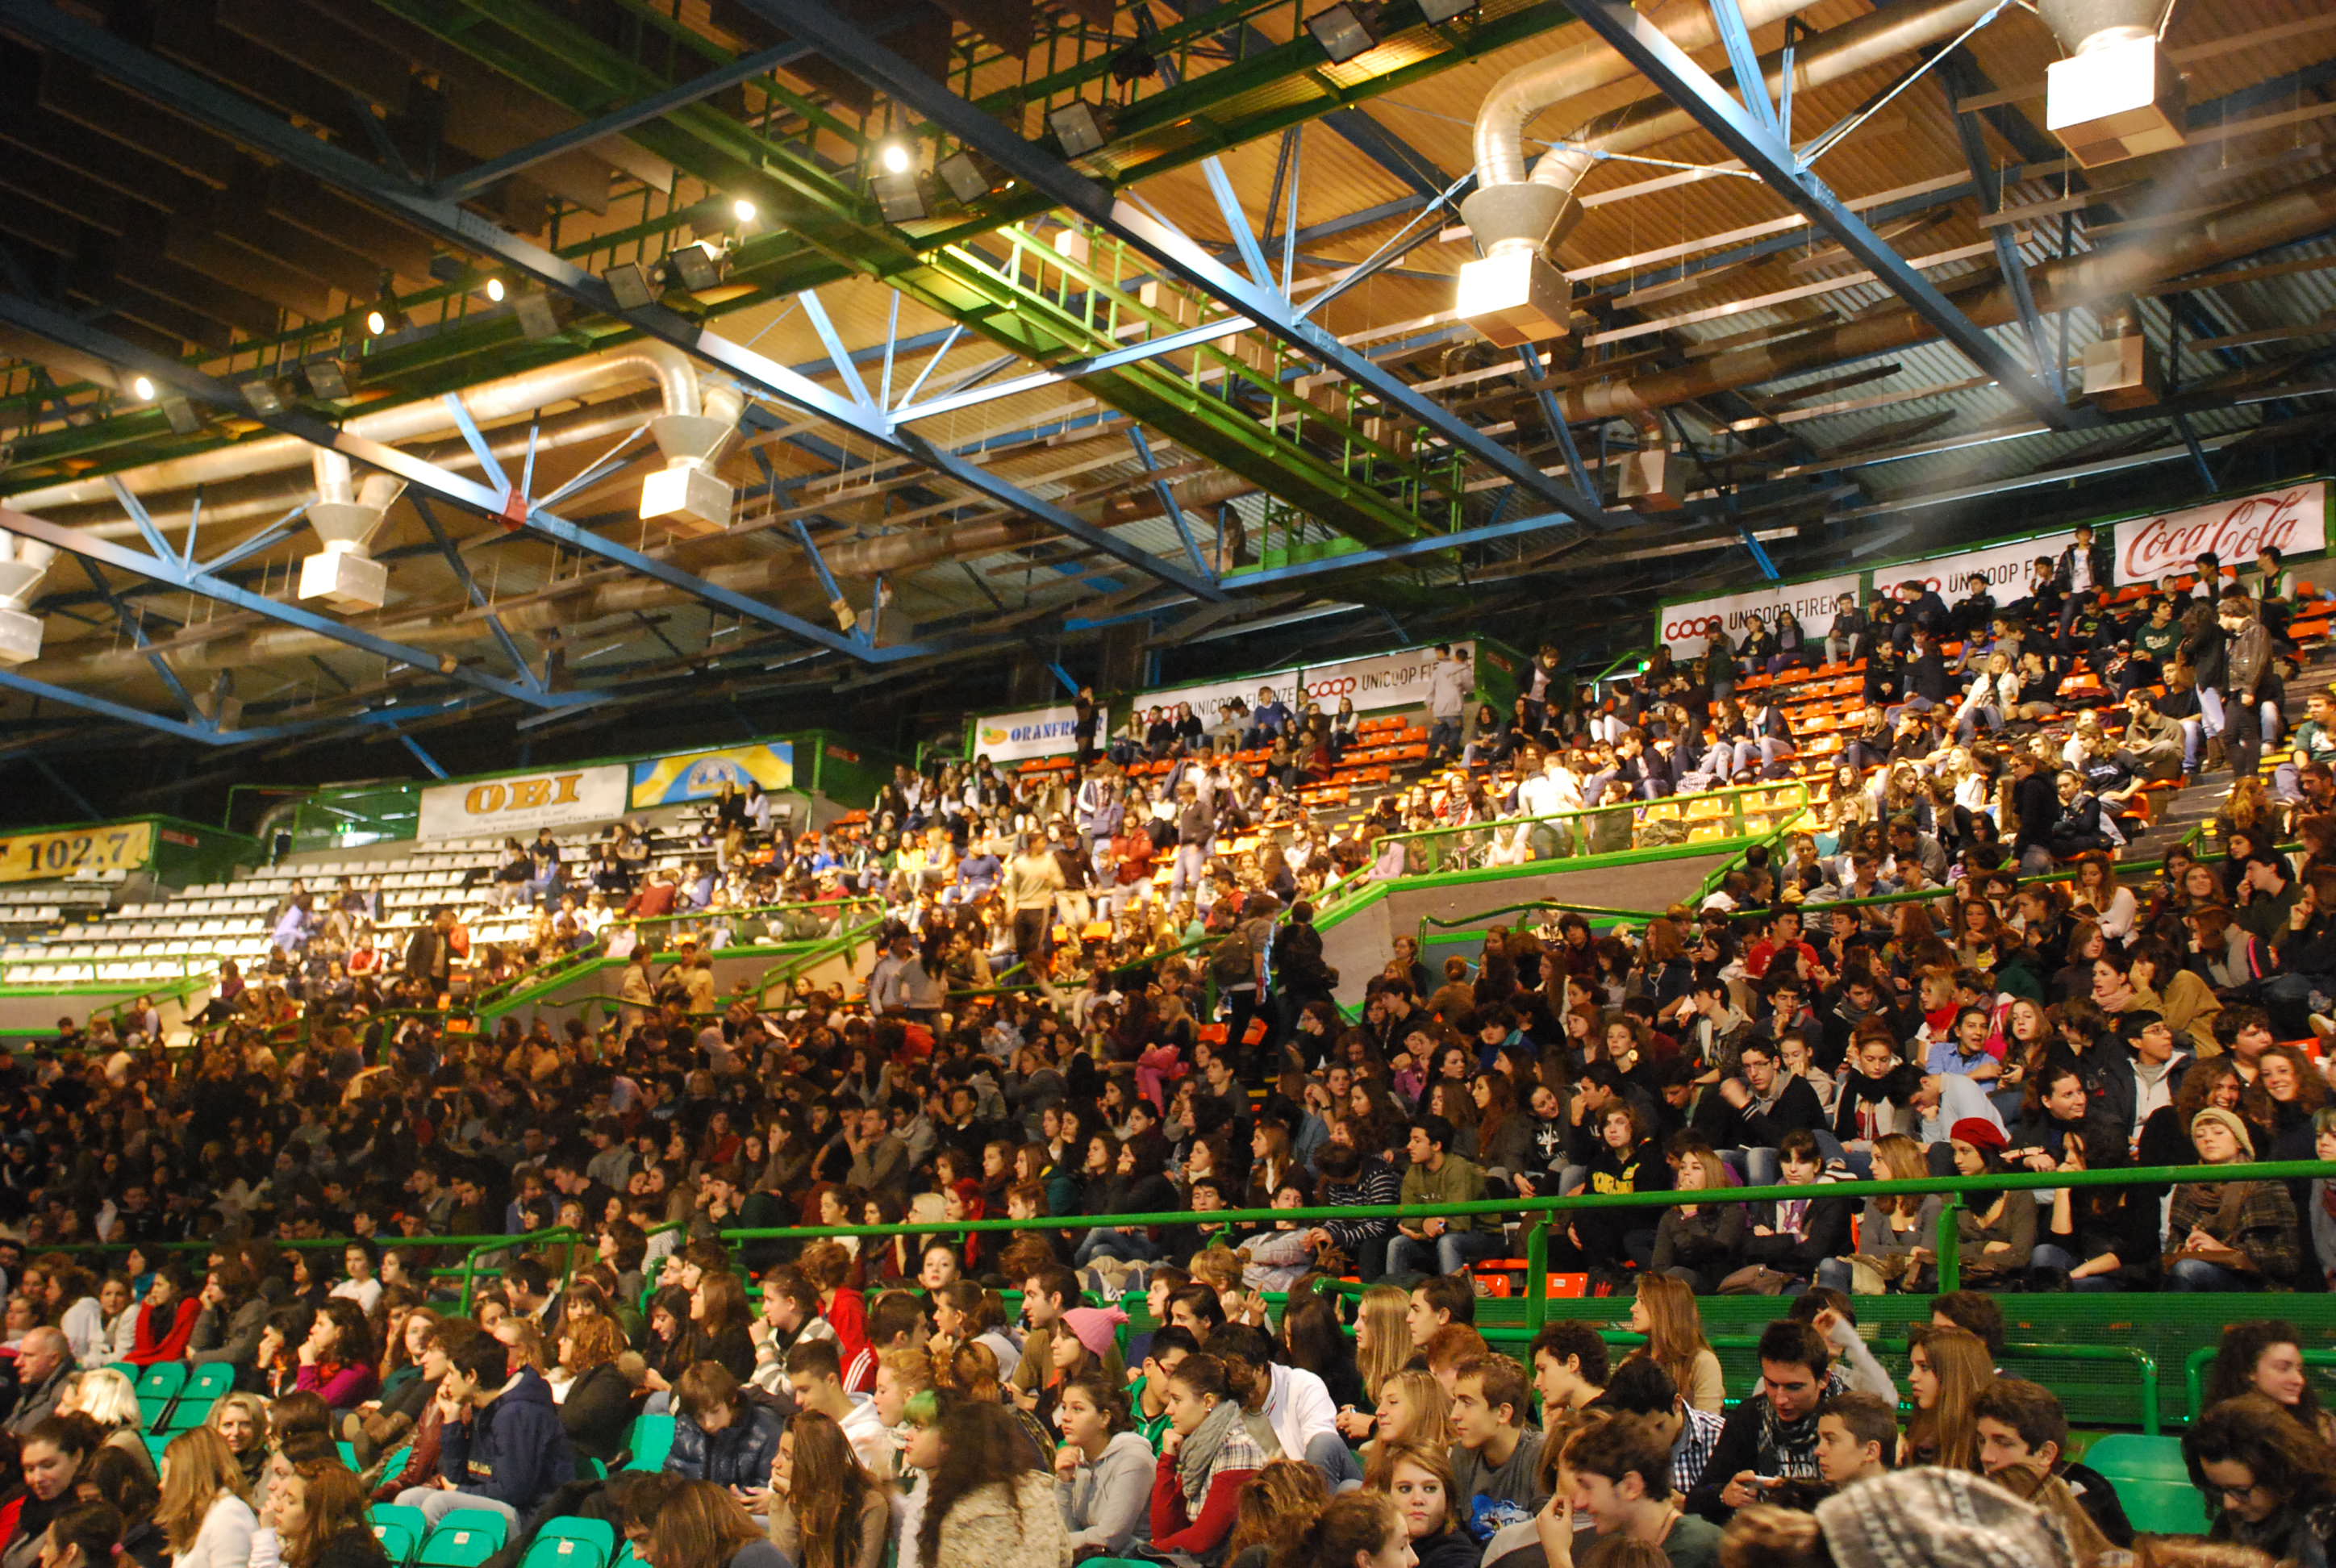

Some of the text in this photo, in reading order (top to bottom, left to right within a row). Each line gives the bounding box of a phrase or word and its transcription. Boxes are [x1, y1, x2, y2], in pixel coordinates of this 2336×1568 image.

[1949, 562, 2018, 593] UNOOP
[1796, 590, 1856, 619] FIREN
[1246, 686, 1295, 709] FINZE
[1011, 715, 1104, 742] ORANFRIR
[465, 773, 583, 815] OBI
[27, 832, 130, 872] 102.7
